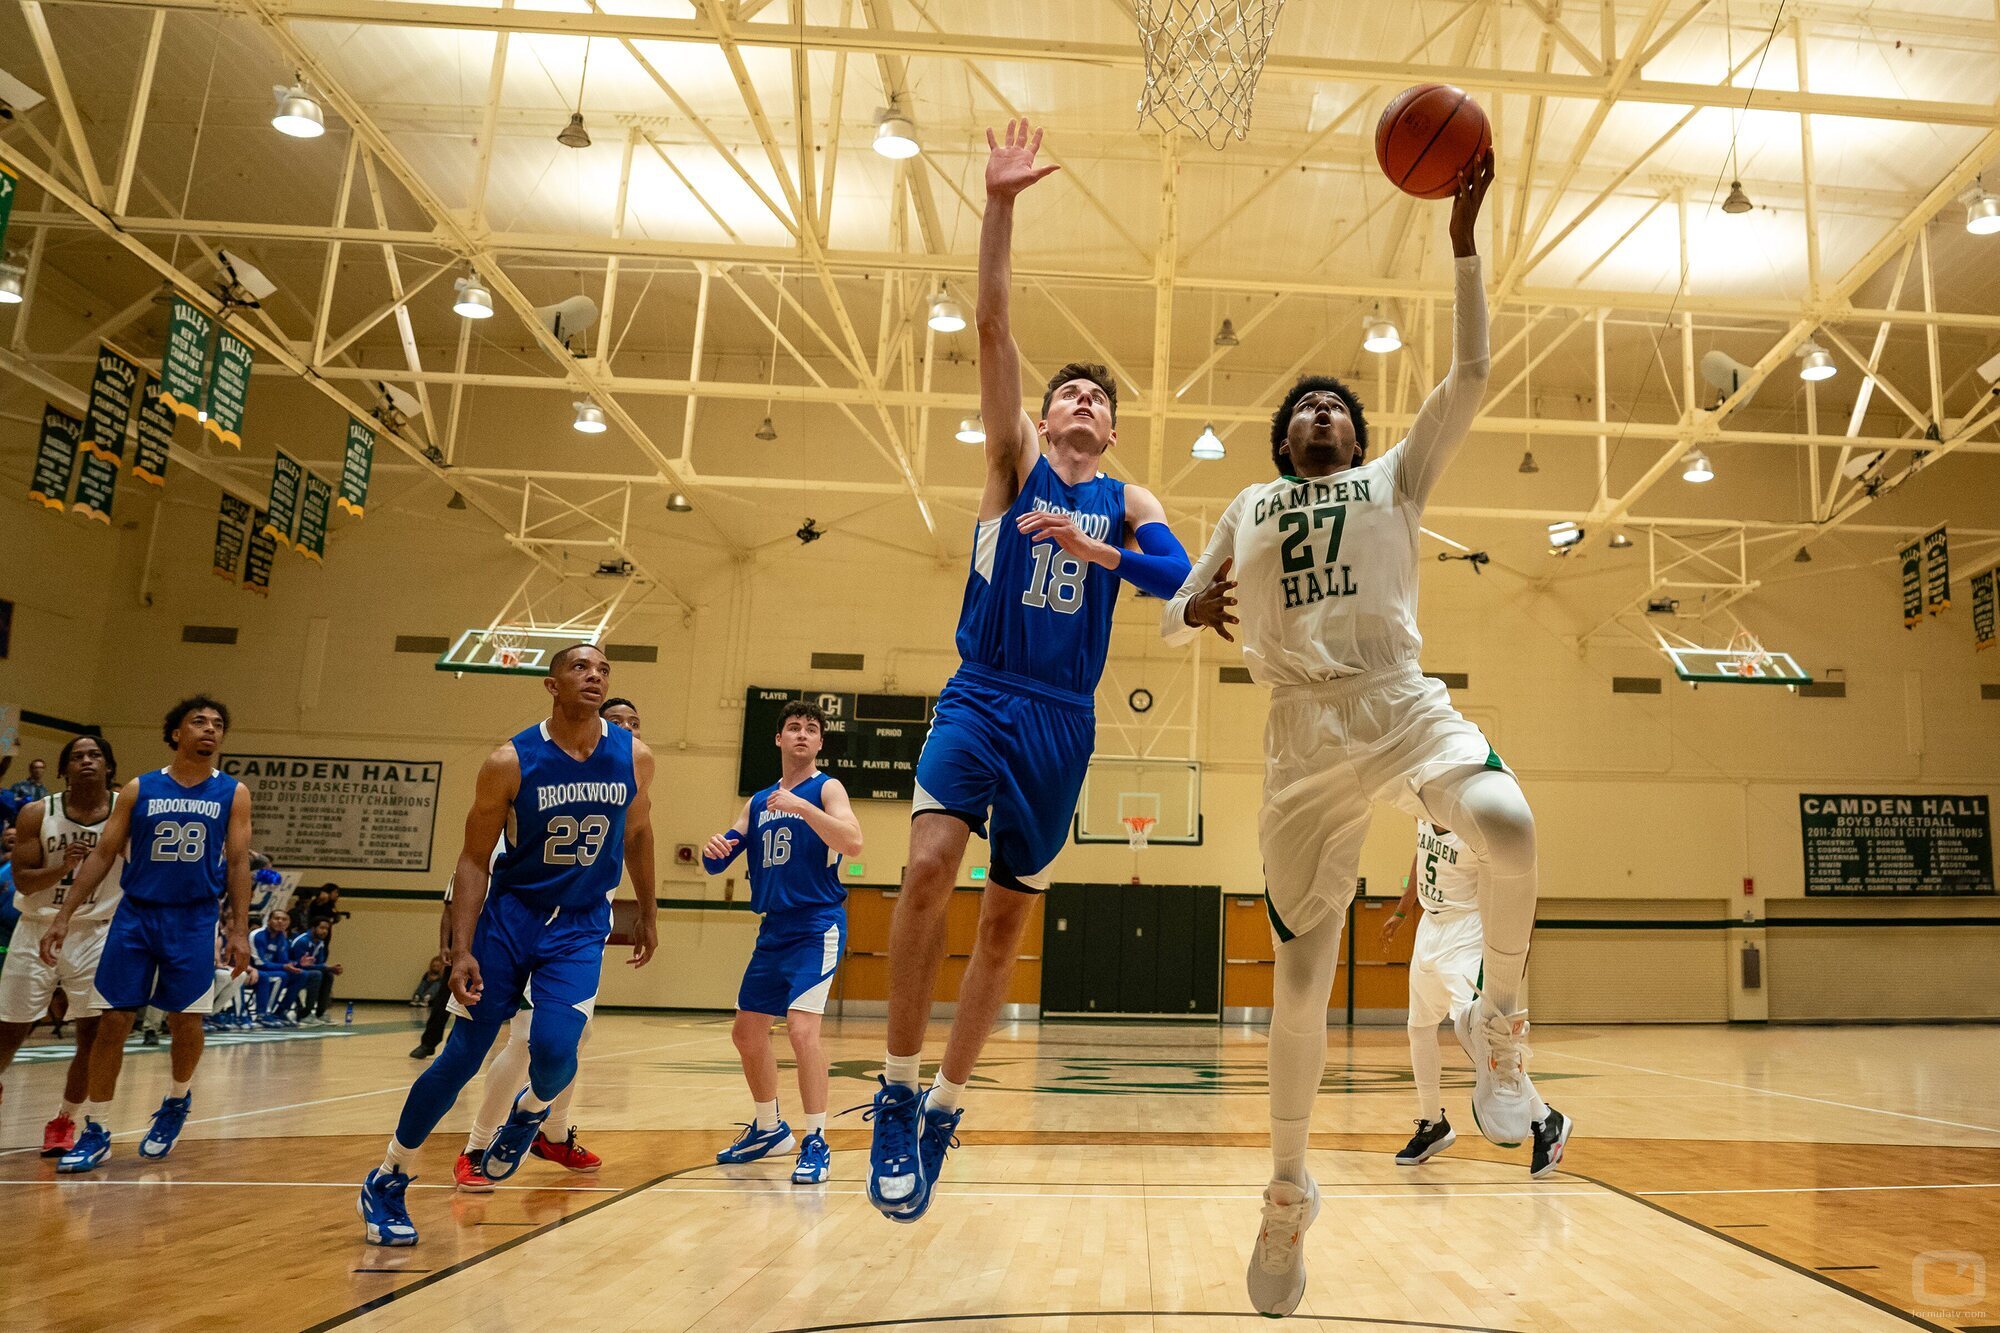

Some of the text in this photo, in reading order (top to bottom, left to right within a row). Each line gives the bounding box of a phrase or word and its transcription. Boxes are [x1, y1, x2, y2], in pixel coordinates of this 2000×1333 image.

[174, 304, 210, 337] VALLEY
[220, 336, 252, 368] VALLEY
[351, 424, 374, 450] VALLEY
[1255, 479, 1371, 526] CAMDEN
[1279, 504, 1347, 574] 27
[1021, 543, 1089, 614] 18
[1281, 565, 1357, 609] HALL
[760, 692, 787, 700] PLAYER
[823, 721, 846, 732] OME
[876, 728, 902, 737] PERIOD
[223, 759, 436, 783] CAMDEN HALL
[863, 760, 890, 769] PLAYER
[893, 761, 912, 770] FOUL
[259, 780, 397, 795] BOYS BASKETBALL
[537, 782, 628, 811] BROOKWOOD
[872, 790, 898, 799] MATCH
[147, 798, 221, 820] BROOKWOOD
[278, 792, 328, 804] DIVISION
[339, 793, 364, 805] CITY
[367, 795, 431, 808] CHAMPIONS
[1804, 798, 1986, 816] CAMDEN HALL
[1808, 827, 1852, 838] 2011-2012
[1855, 827, 1896, 838] DIVISION
[1906, 828, 1927, 838] CITY
[1930, 828, 1983, 838] CHAMPIONS
[1837, 817, 1955, 828] BOYS BASKETBALL
[47, 831, 98, 853] CAMD
[151, 821, 207, 862] 28
[543, 814, 610, 866] 23
[762, 826, 792, 868] 16
[1425, 853, 1438, 885] 5
